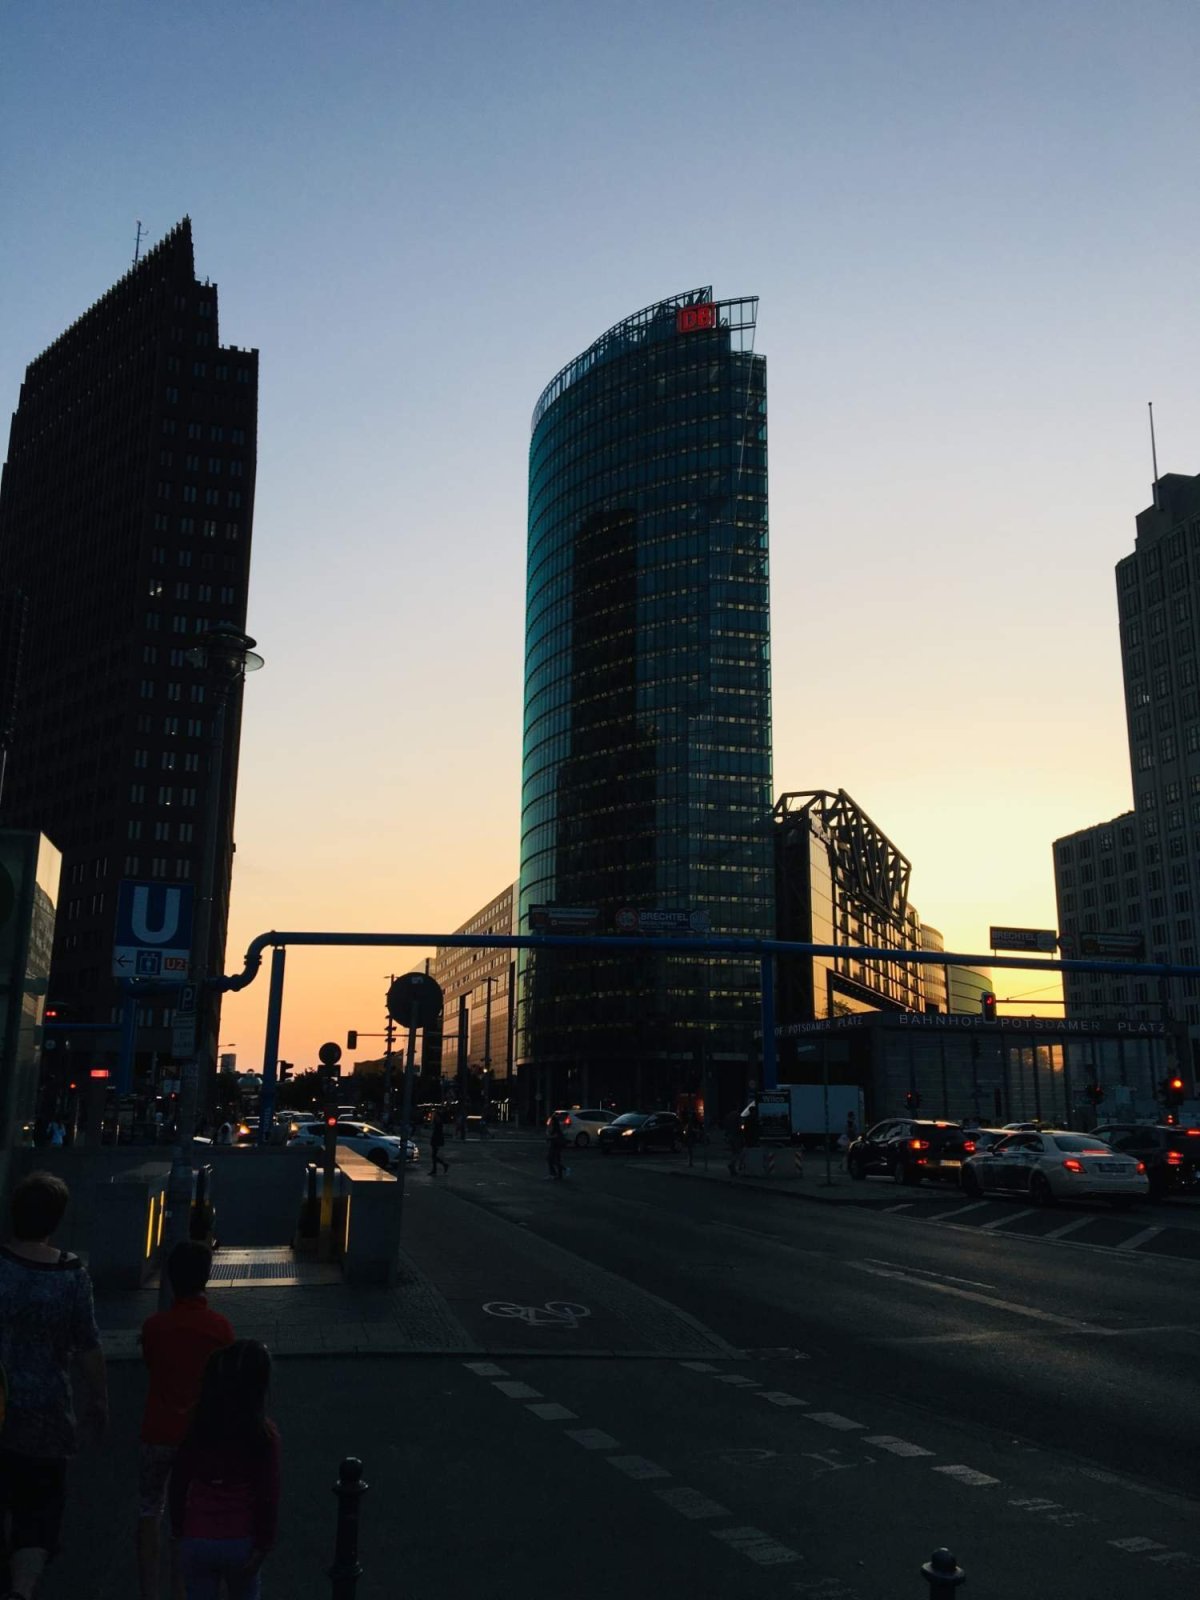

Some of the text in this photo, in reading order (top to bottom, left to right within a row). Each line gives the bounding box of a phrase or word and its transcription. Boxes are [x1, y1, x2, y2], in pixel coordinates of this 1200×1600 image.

[682, 308, 710, 331] DB
[131, 886, 181, 944] U
[641, 912, 690, 922] BRECHTEL
[166, 958, 185, 970] U2
[183, 989, 193, 1009] P
[788, 1020, 831, 1033] POTSDAMER
[837, 1015, 864, 1027] PLATZ
[899, 1014, 1167, 1034] BAHNHOF POTSDAMER PLATZ
